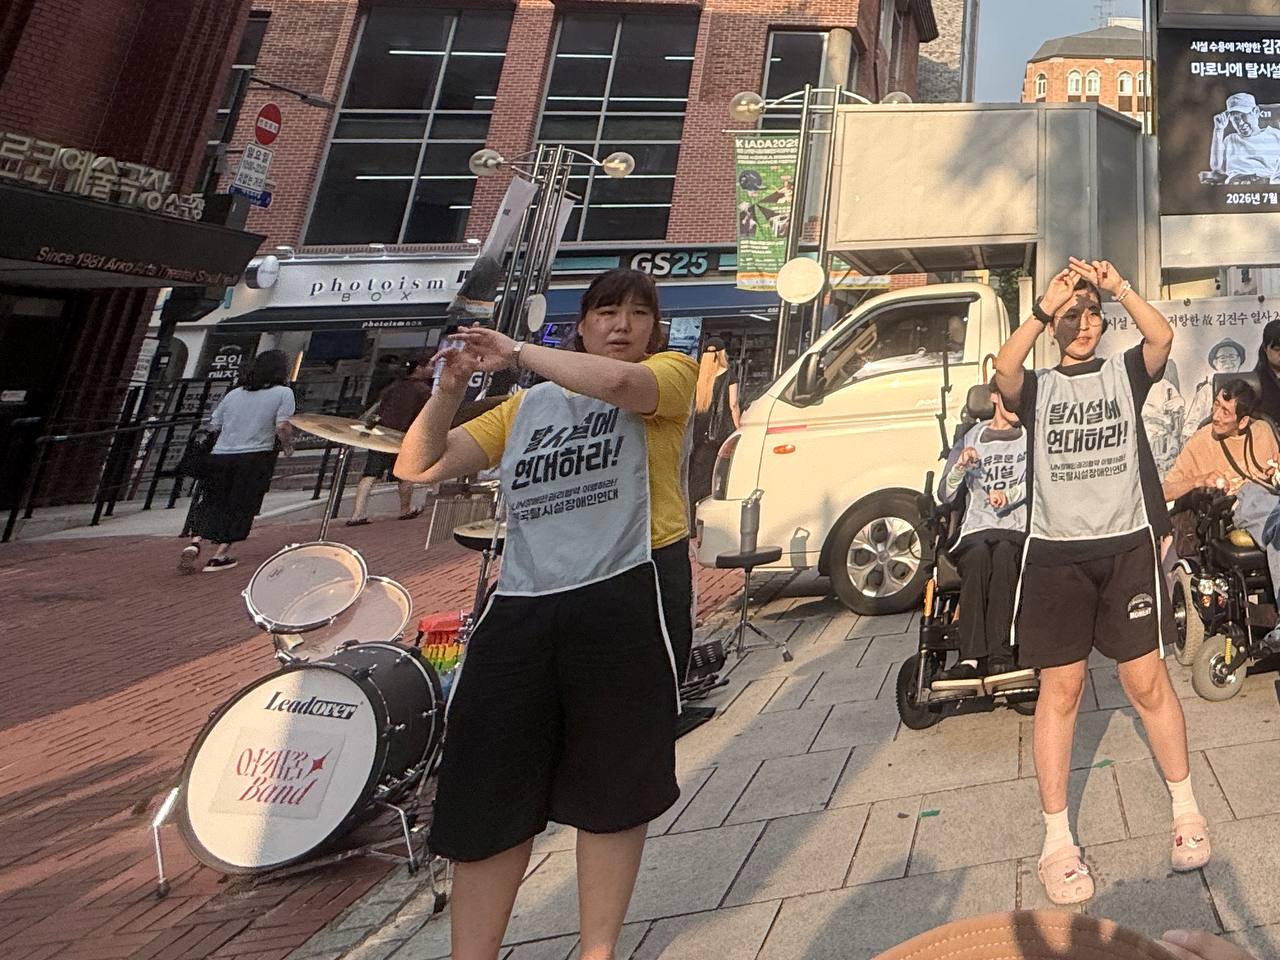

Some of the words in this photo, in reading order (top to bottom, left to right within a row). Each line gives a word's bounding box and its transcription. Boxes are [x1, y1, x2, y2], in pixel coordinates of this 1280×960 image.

[1190, 41, 1208, 52] 시설
[1191, 62, 1242, 77] 마로니에
[1226, 192, 1260, 205] 2026년
[1262, 192, 1278, 204] 7월
[36, 246, 75, 264] Since
[76, 252, 106, 269] 1981
[105, 258, 134, 273] Arko
[631, 252, 708, 275] GS25
[310, 276, 444, 296] photoism
[341, 291, 411, 302] BOX
[1168, 313, 1200, 329] 저항한
[1202, 315, 1213, 326] 故
[1216, 311, 1248, 327] 김진수
[1251, 309, 1271, 324] 열사
[211, 354, 242, 369] 무인
[1049, 398, 1121, 425] 탈시설에
[523, 407, 620, 455] 탈시설에
[1047, 421, 1128, 454] 연대하라!
[511, 435, 624, 490] 연대하라!
[1050, 462, 1127, 482] 전국탈시설장애인연대
[984, 465, 1014, 483] 시설
[264, 692, 358, 719] Leadover
